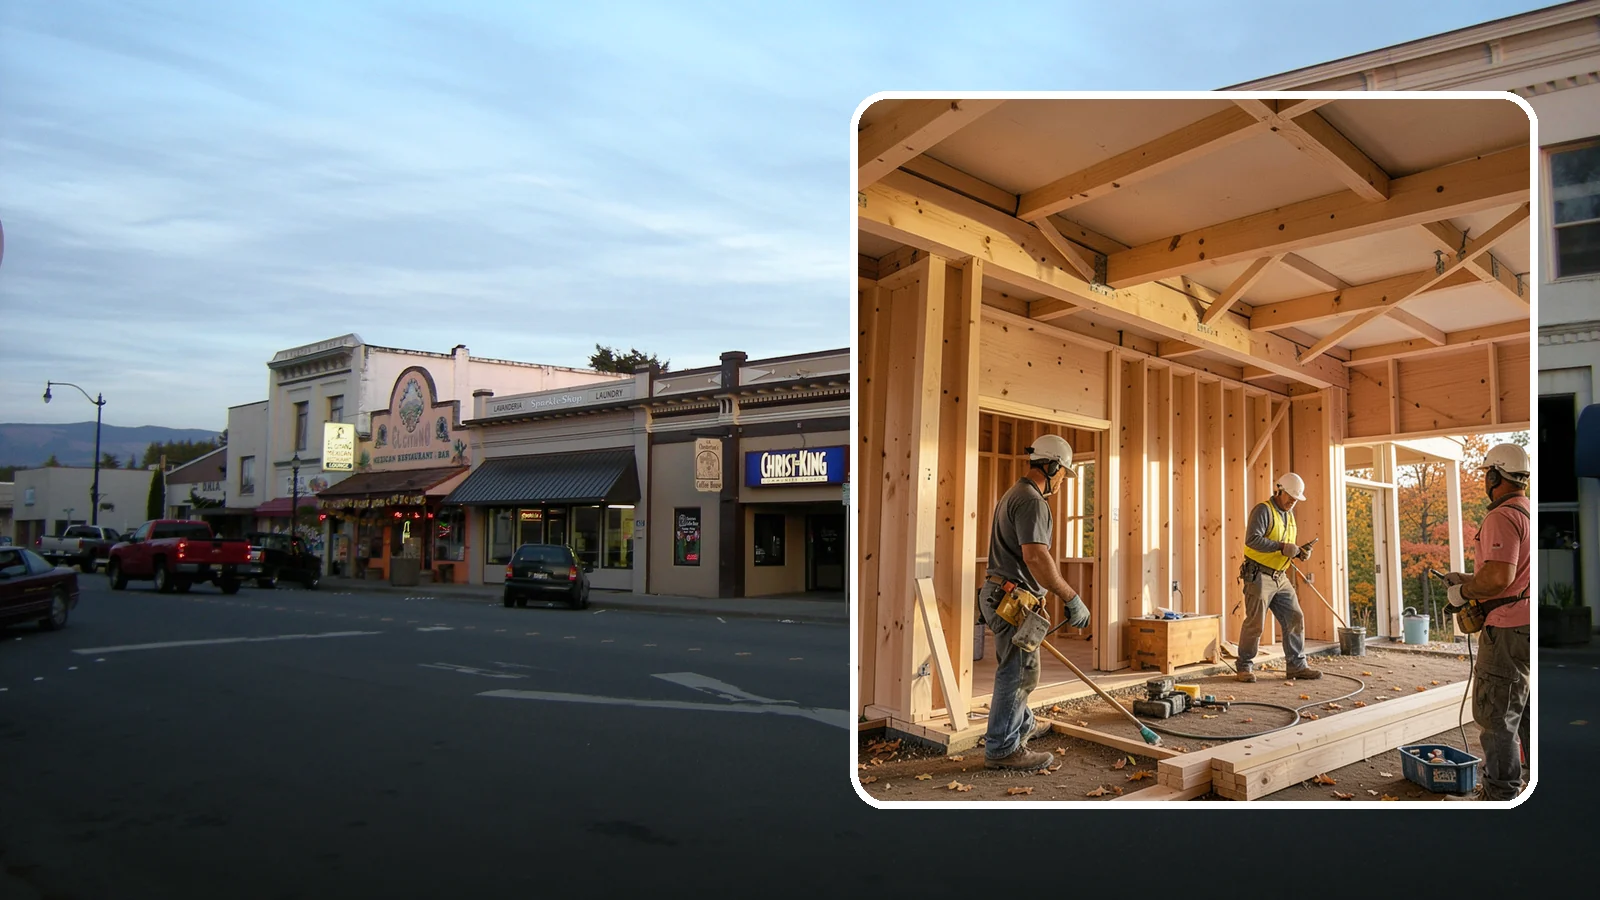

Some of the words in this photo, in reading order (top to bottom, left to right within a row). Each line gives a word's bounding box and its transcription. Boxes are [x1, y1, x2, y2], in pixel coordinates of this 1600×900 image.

[595, 388, 623, 400] LAUNDRY
[493, 402, 522, 412] LAVANDERIA
[530, 396, 559, 409] Sparkle
[560, 394, 582, 405] Shop
[373, 455, 396, 464] MEXICAN
[398, 452, 433, 462] RESTAURANT
[437, 450, 450, 459] BAR
[761, 452, 797, 478] CHRIST
[799, 450, 827, 476] KING
